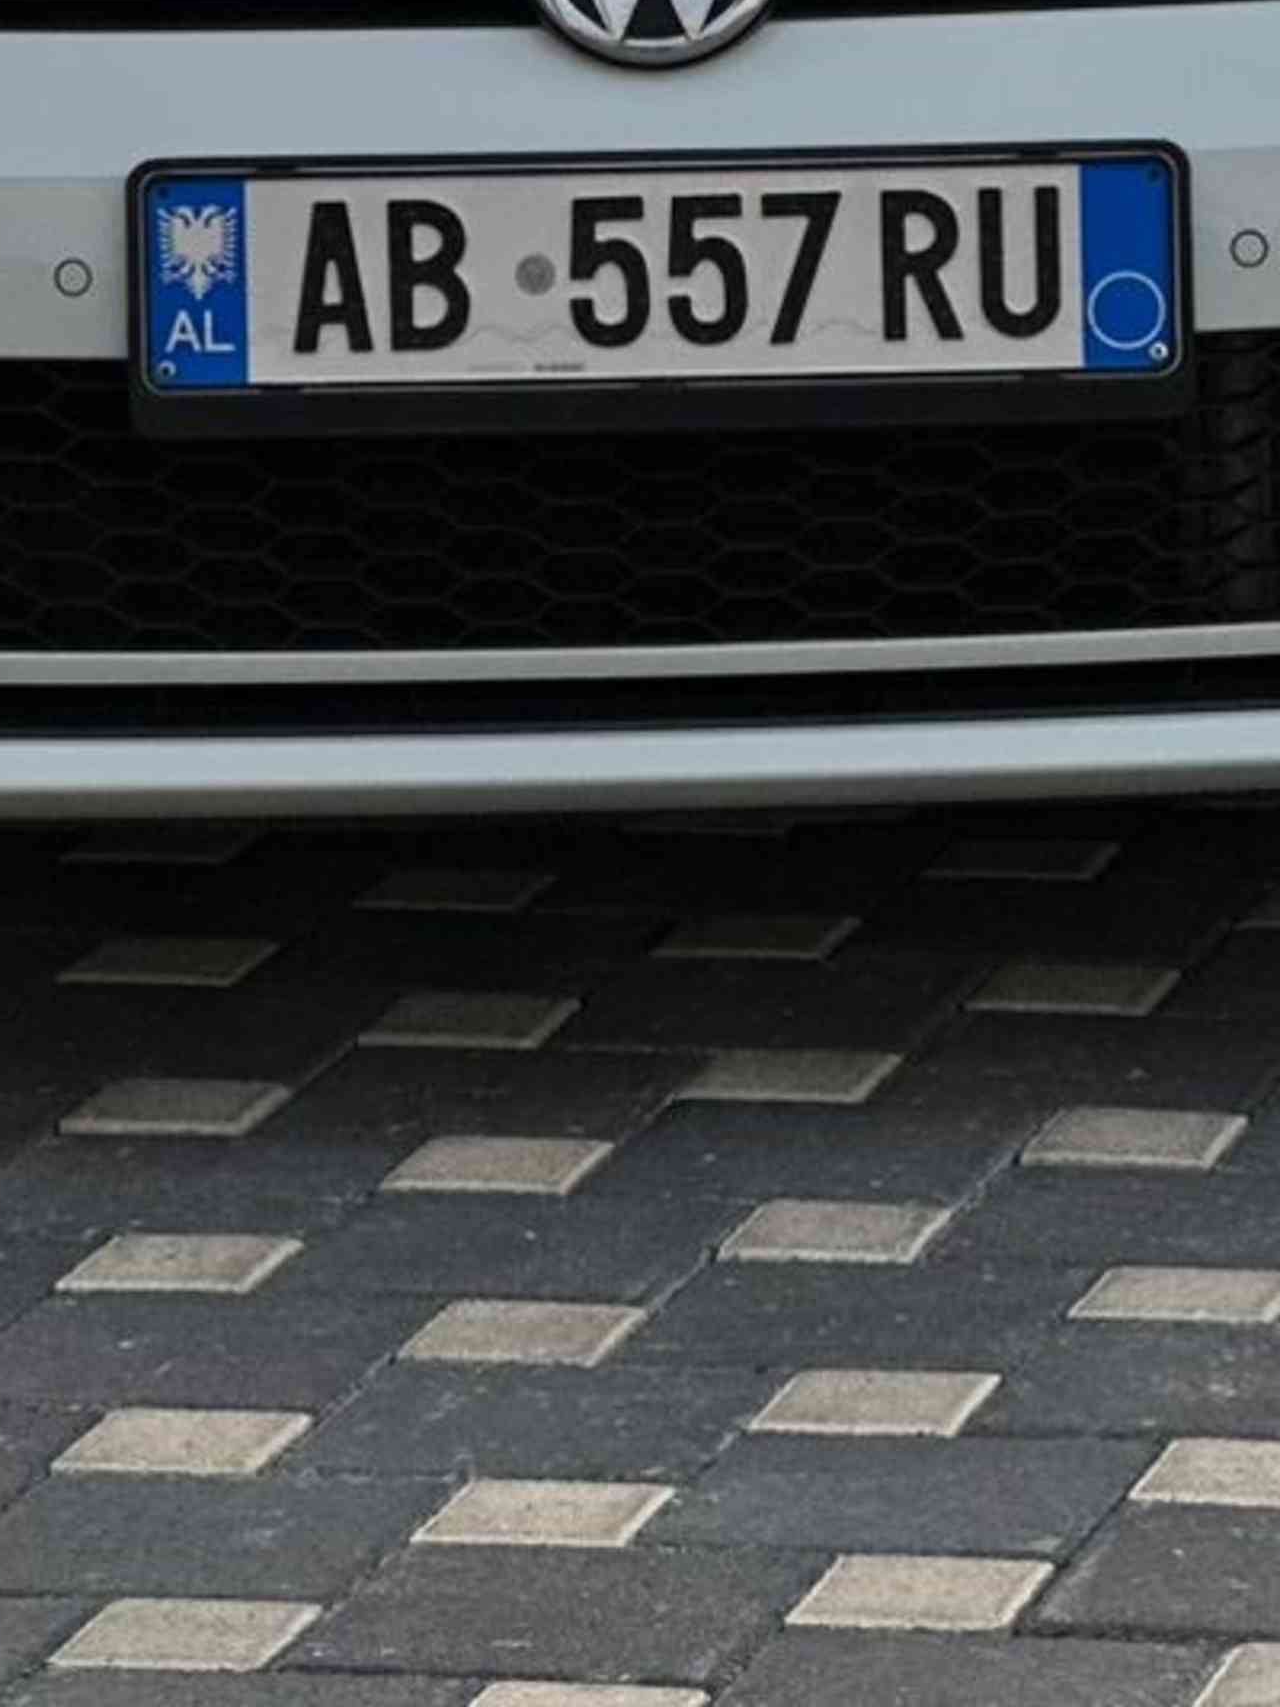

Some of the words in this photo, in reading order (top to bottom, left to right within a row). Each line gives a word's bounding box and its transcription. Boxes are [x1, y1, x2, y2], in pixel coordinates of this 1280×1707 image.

[294, 199, 471, 353] AB
[569, 191, 842, 348] 557
[879, 186, 1061, 342] RU
[166, 311, 236, 352] AL
